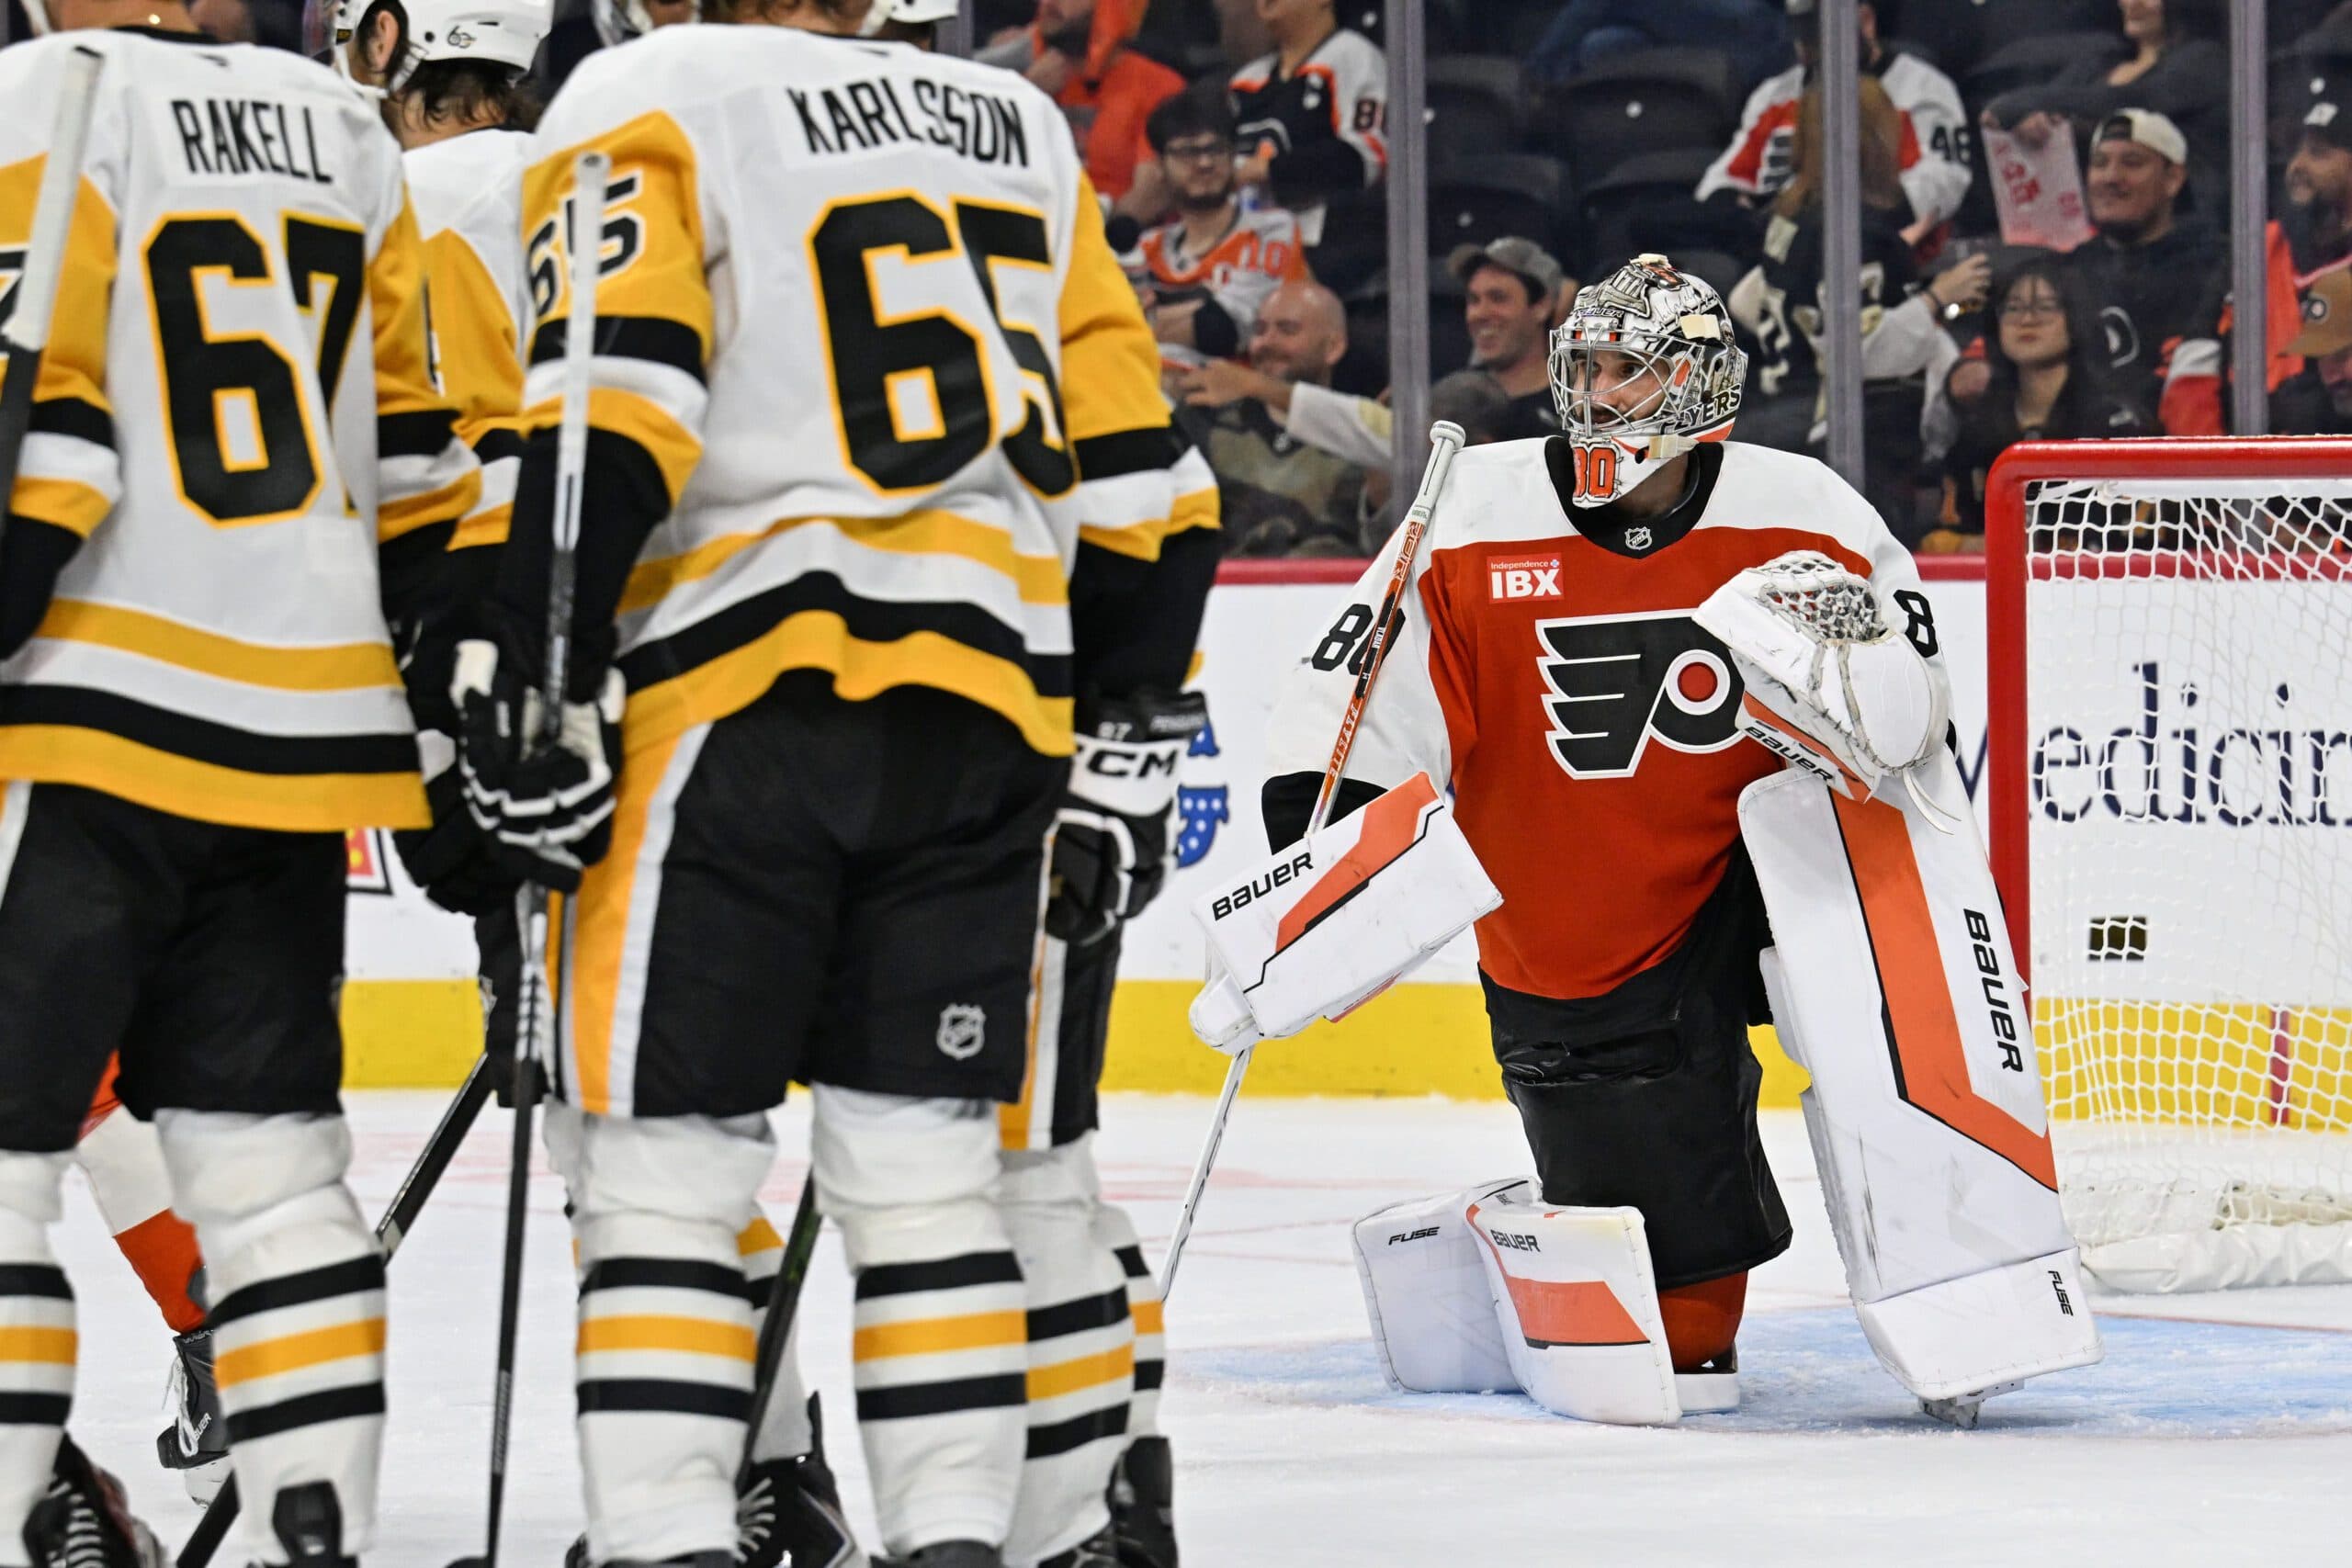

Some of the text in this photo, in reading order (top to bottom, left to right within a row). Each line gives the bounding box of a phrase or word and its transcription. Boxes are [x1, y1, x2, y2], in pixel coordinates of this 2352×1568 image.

[171, 97, 334, 186] RAKELL
[786, 78, 1030, 168] KARLSSON
[1352, 98, 1389, 138] 8
[804, 187, 1080, 498] 65
[140, 209, 368, 529] 67
[1490, 559, 1549, 571] Independence
[1491, 568, 1562, 599] IBX
[1075, 745, 1178, 778] CM
[1745, 726, 1834, 781] BAUER
[1212, 852, 1314, 921] BAUER
[1963, 908, 2024, 1072] BAUER
[1388, 1226, 1441, 1246] FUSE
[1490, 1229, 1541, 1253] BAUER
[2048, 1270, 2074, 1316] FUSE
